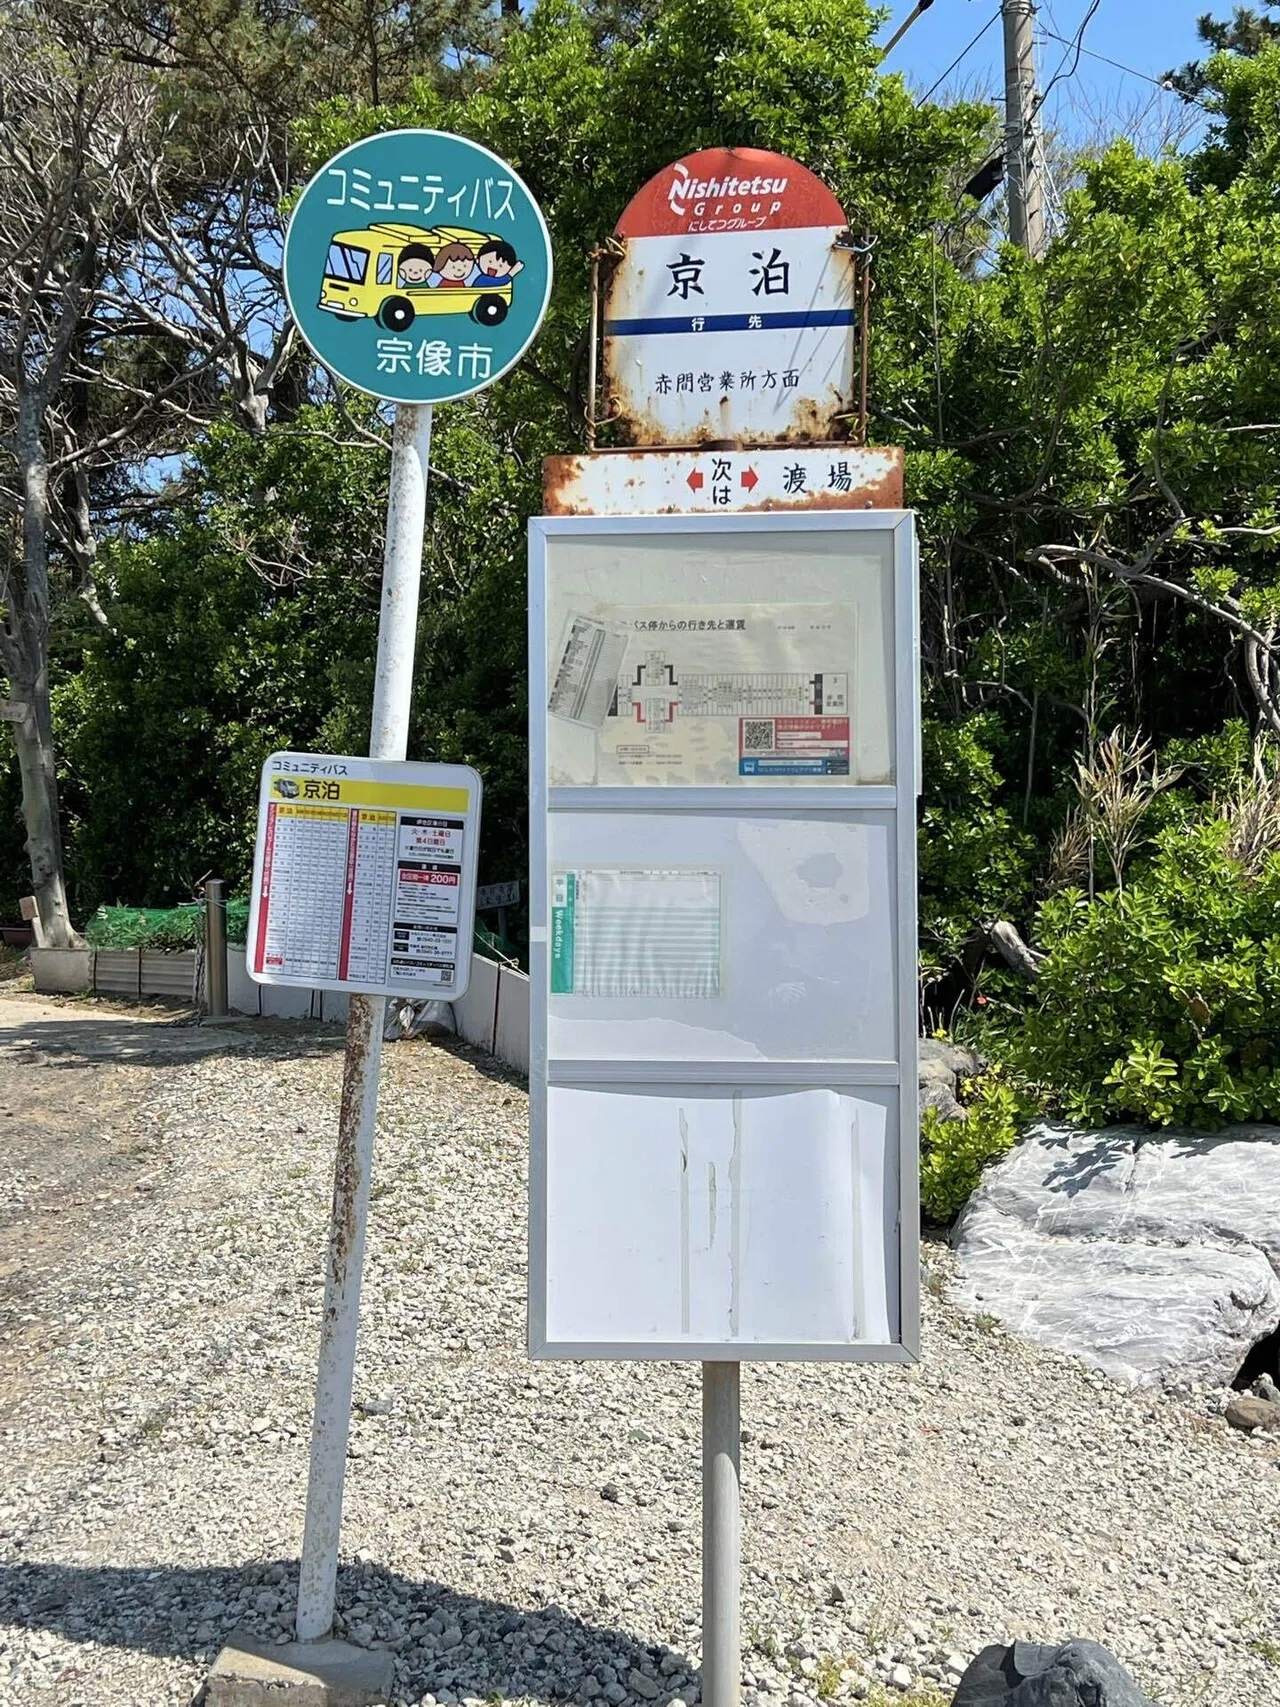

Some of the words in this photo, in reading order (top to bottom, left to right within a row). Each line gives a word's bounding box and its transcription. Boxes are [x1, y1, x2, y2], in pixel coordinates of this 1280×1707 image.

[326, 168, 516, 221] コミュニティバス
[667, 175, 788, 201] Nishitetsu
[693, 200, 784, 217] Group
[688, 216, 767, 232] にしてつグループ
[666, 248, 790, 300] 京泊
[691, 314, 762, 332] 行先
[376, 337, 493, 380] 宗像市
[655, 368, 800, 395] 赤間営業所方面
[712, 458, 733, 505] 次は
[783, 462, 852, 494] 渡場
[272, 760, 348, 776] コミュニティバス
[303, 780, 340, 801] 京泊
[554, 909, 564, 958] Weekdays
